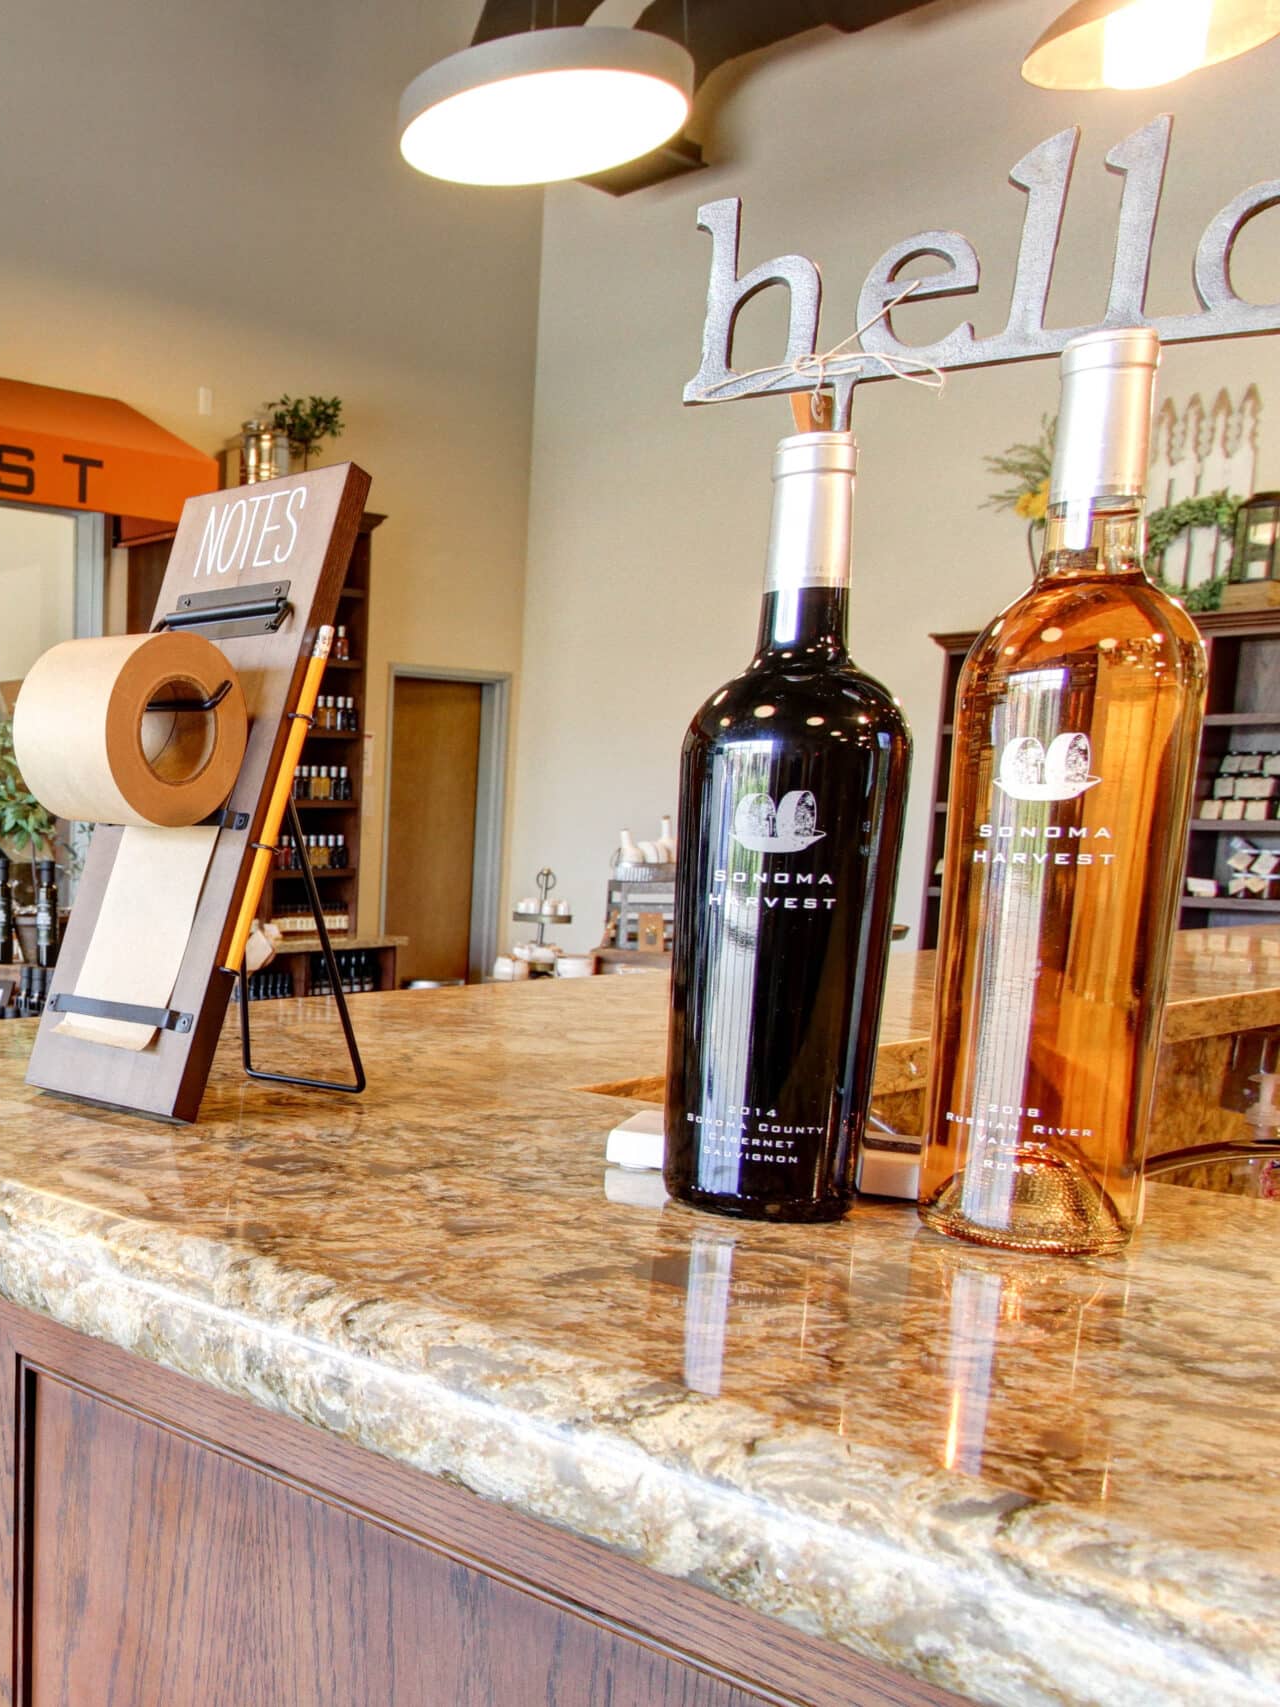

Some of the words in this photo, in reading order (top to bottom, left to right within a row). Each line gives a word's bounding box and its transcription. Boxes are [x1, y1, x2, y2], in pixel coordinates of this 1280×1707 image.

[193, 486, 308, 578] NOTES
[979, 824, 1112, 839] SONOMA
[973, 849, 1116, 866] HARVEST
[713, 869, 834, 885] SONOMA
[708, 893, 838, 910] HARVEST
[727, 1105, 778, 1118] 2014
[988, 1104, 1041, 1118] 2018
[686, 1112, 747, 1131] SONOMA
[758, 1123, 825, 1136] COUNTY
[1032, 1124, 1093, 1137] RIVER
[708, 1132, 795, 1150] CABERNET
[976, 1132, 1049, 1150] VALLEY
[703, 1145, 799, 1164] SAUVIGNON
